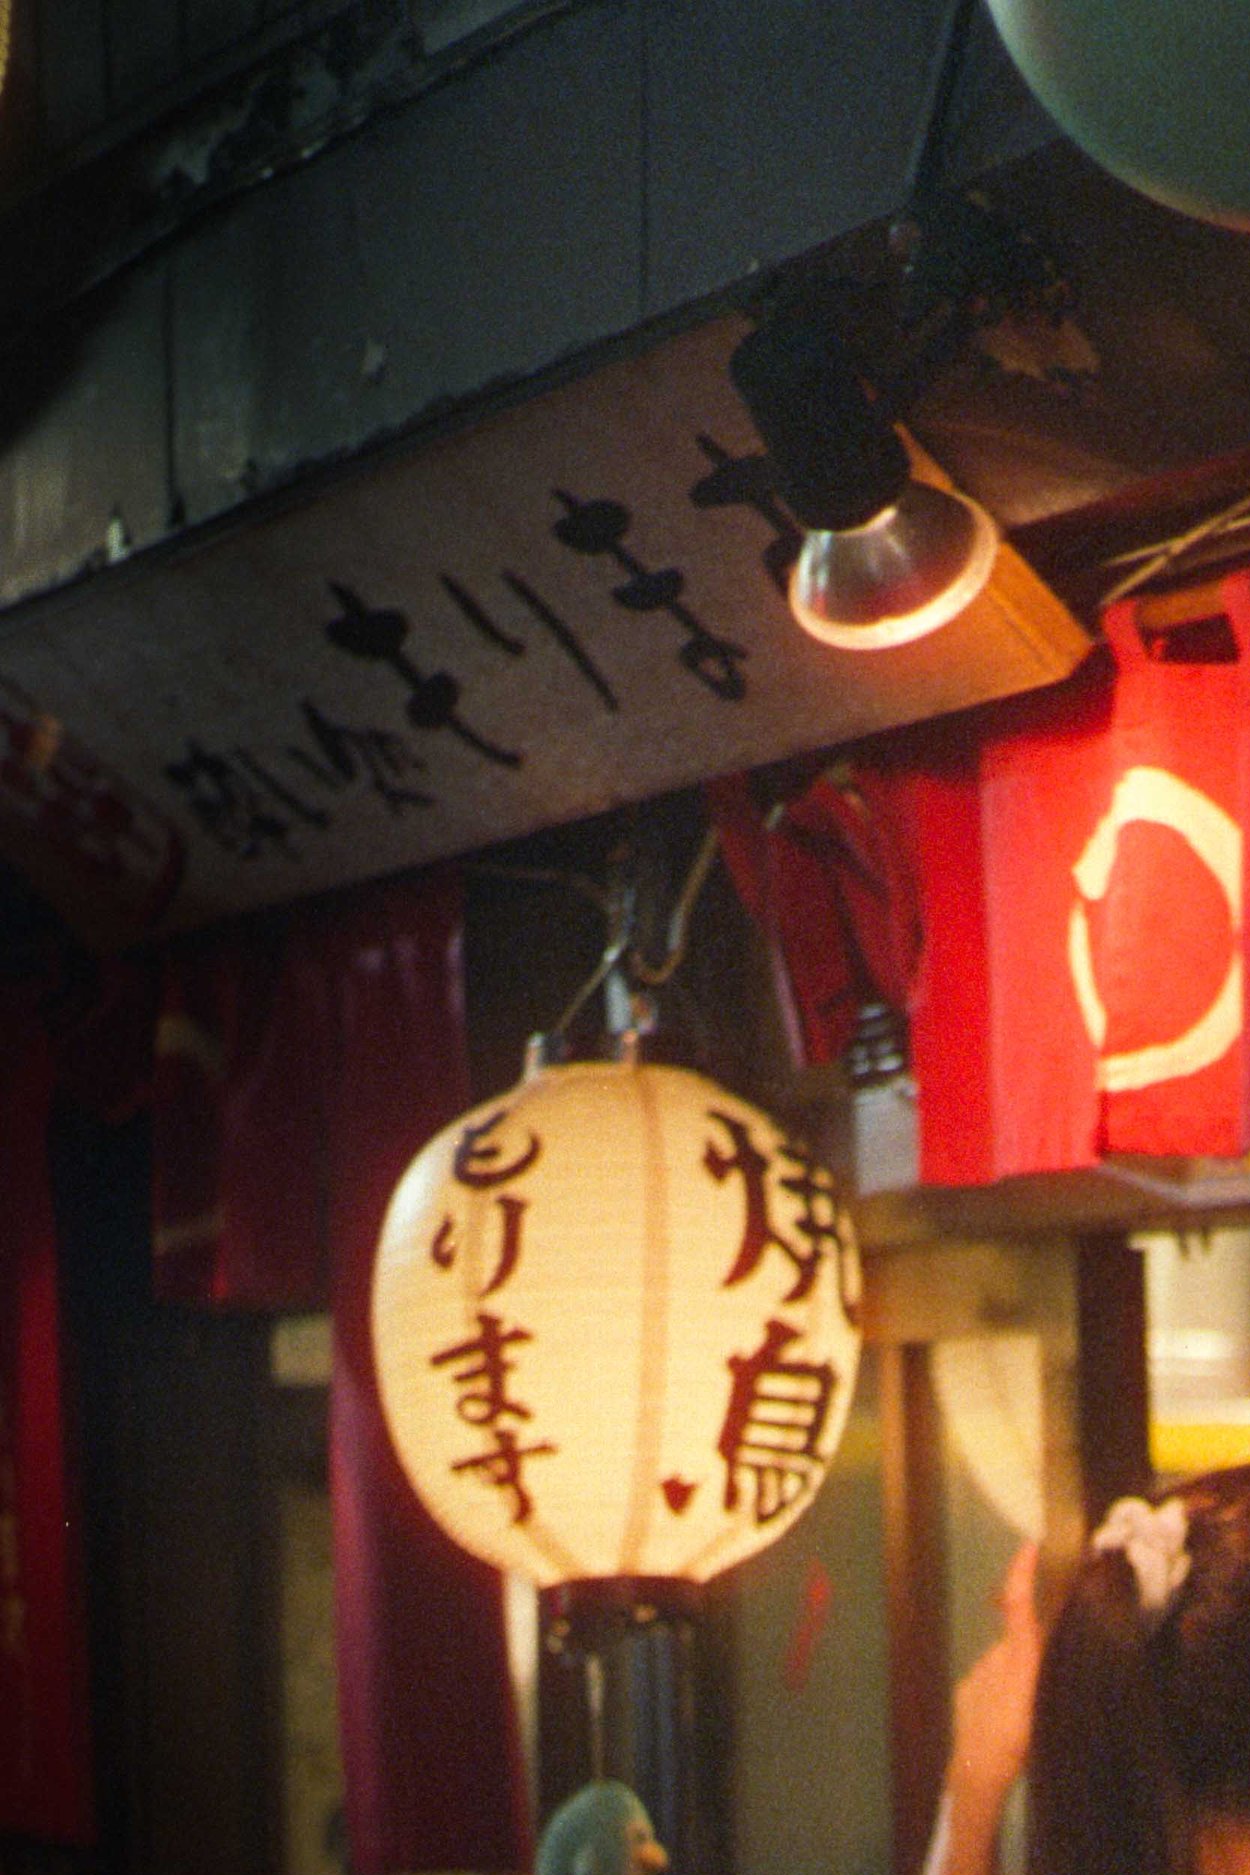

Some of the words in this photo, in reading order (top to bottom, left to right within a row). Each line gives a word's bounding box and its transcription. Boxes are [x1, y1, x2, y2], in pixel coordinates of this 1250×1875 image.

[430, 1107, 557, 1525] もります
[661, 1107, 865, 1525] 焼鳥
